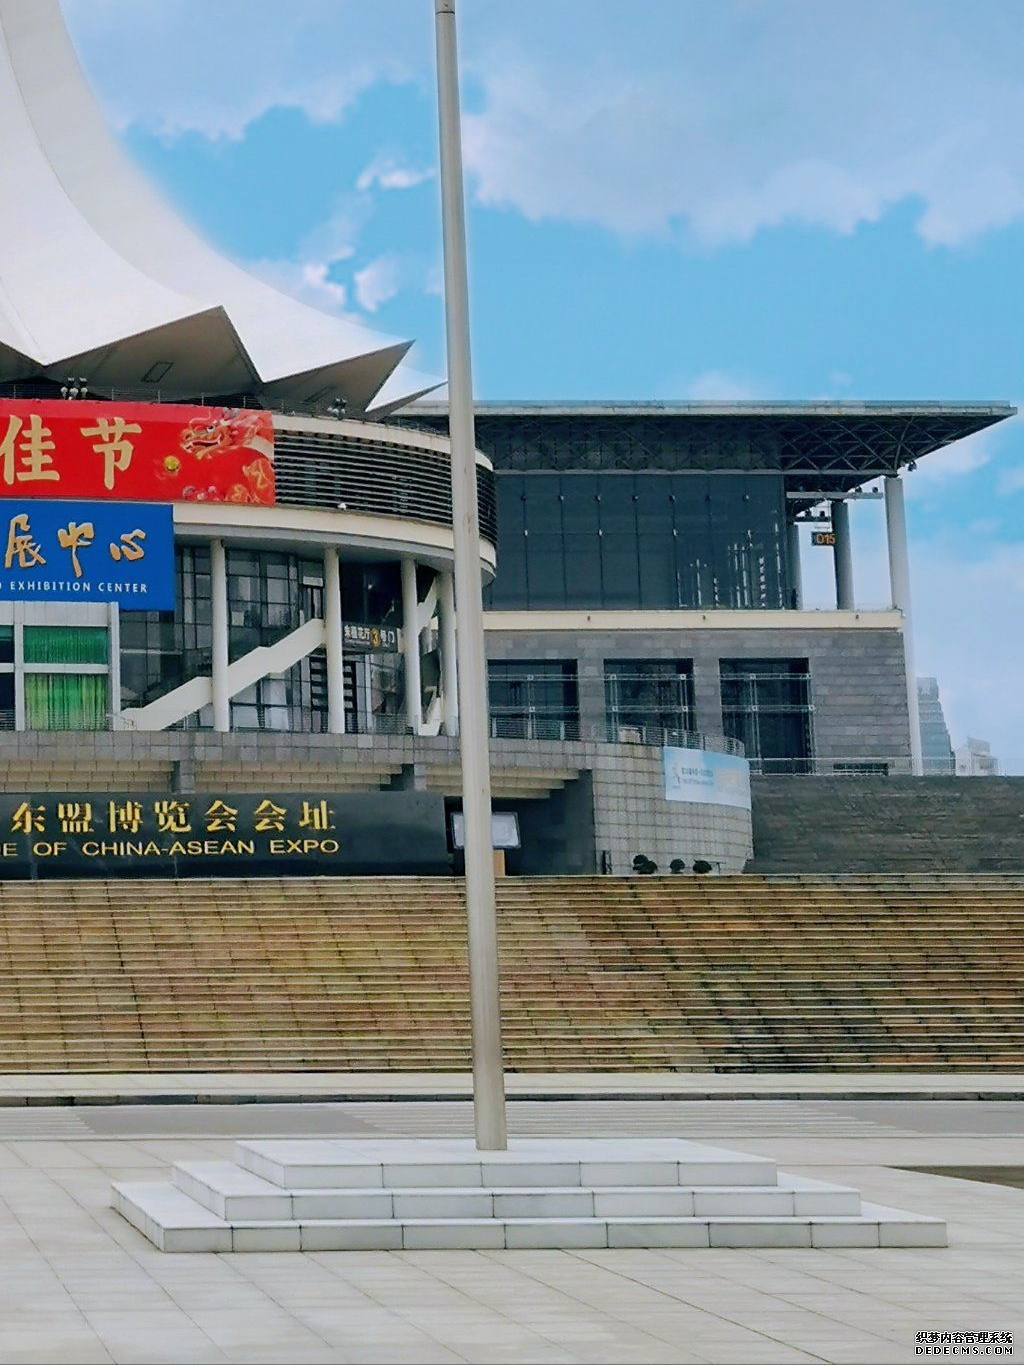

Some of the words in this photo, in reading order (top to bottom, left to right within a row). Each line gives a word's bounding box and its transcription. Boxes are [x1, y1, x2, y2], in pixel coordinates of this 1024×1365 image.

[10, 581, 91, 592] EXHIBITION
[98, 582, 147, 593] CENTER
[33, 841, 67, 856] OF
[82, 839, 255, 856] CHINA-ASEAN
[270, 839, 339, 854] EXPO
